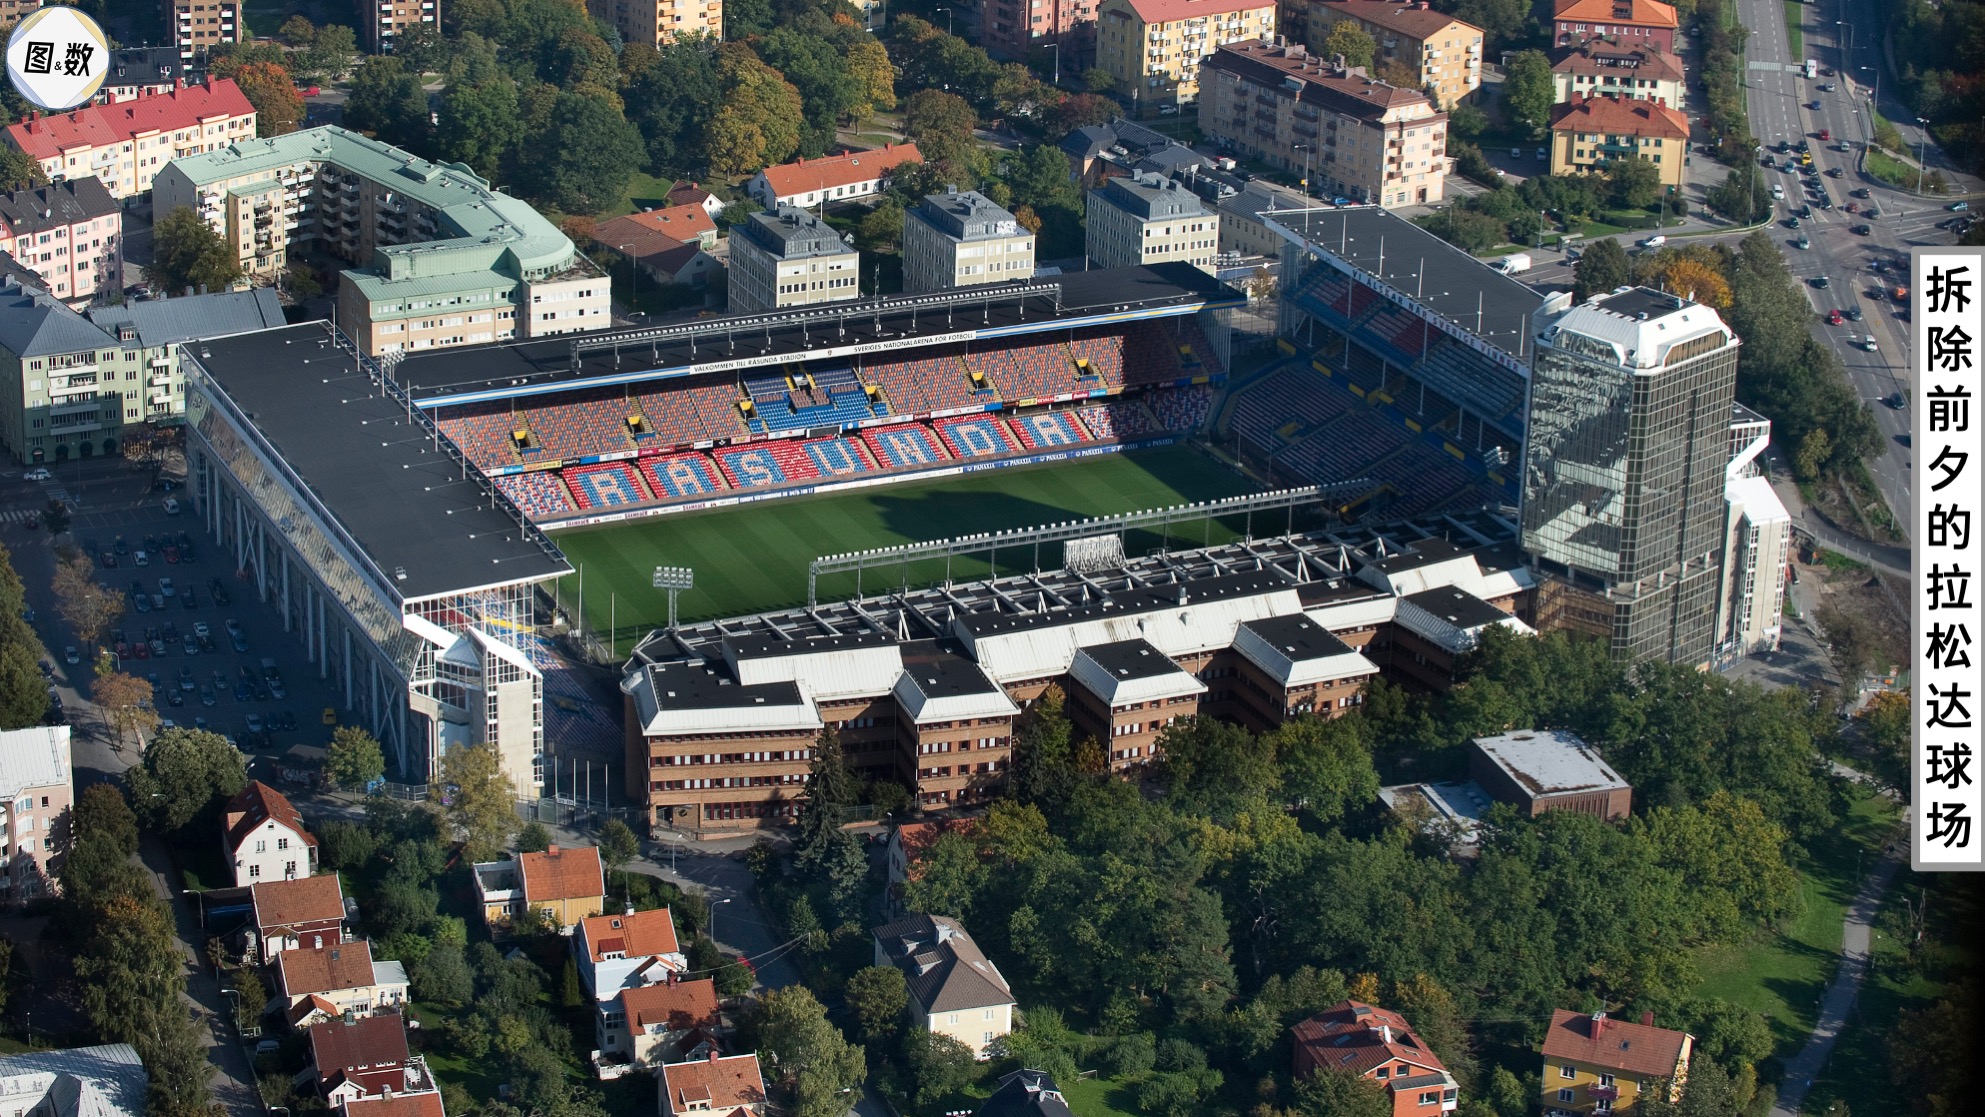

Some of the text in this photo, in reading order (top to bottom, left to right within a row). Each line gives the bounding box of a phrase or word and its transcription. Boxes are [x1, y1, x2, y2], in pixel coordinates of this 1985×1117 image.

[854, 343, 882, 352] SVERIGES
[883, 337, 934, 349] NATIONALARENA
[779, 353, 807, 362] STADION
[1081, 448, 1104, 457] PANAXIA
[1045, 453, 1068, 462] PANAXIA
[973, 462, 996, 471] PANAXIA
[1009, 458, 1032, 467] PANAXIA
